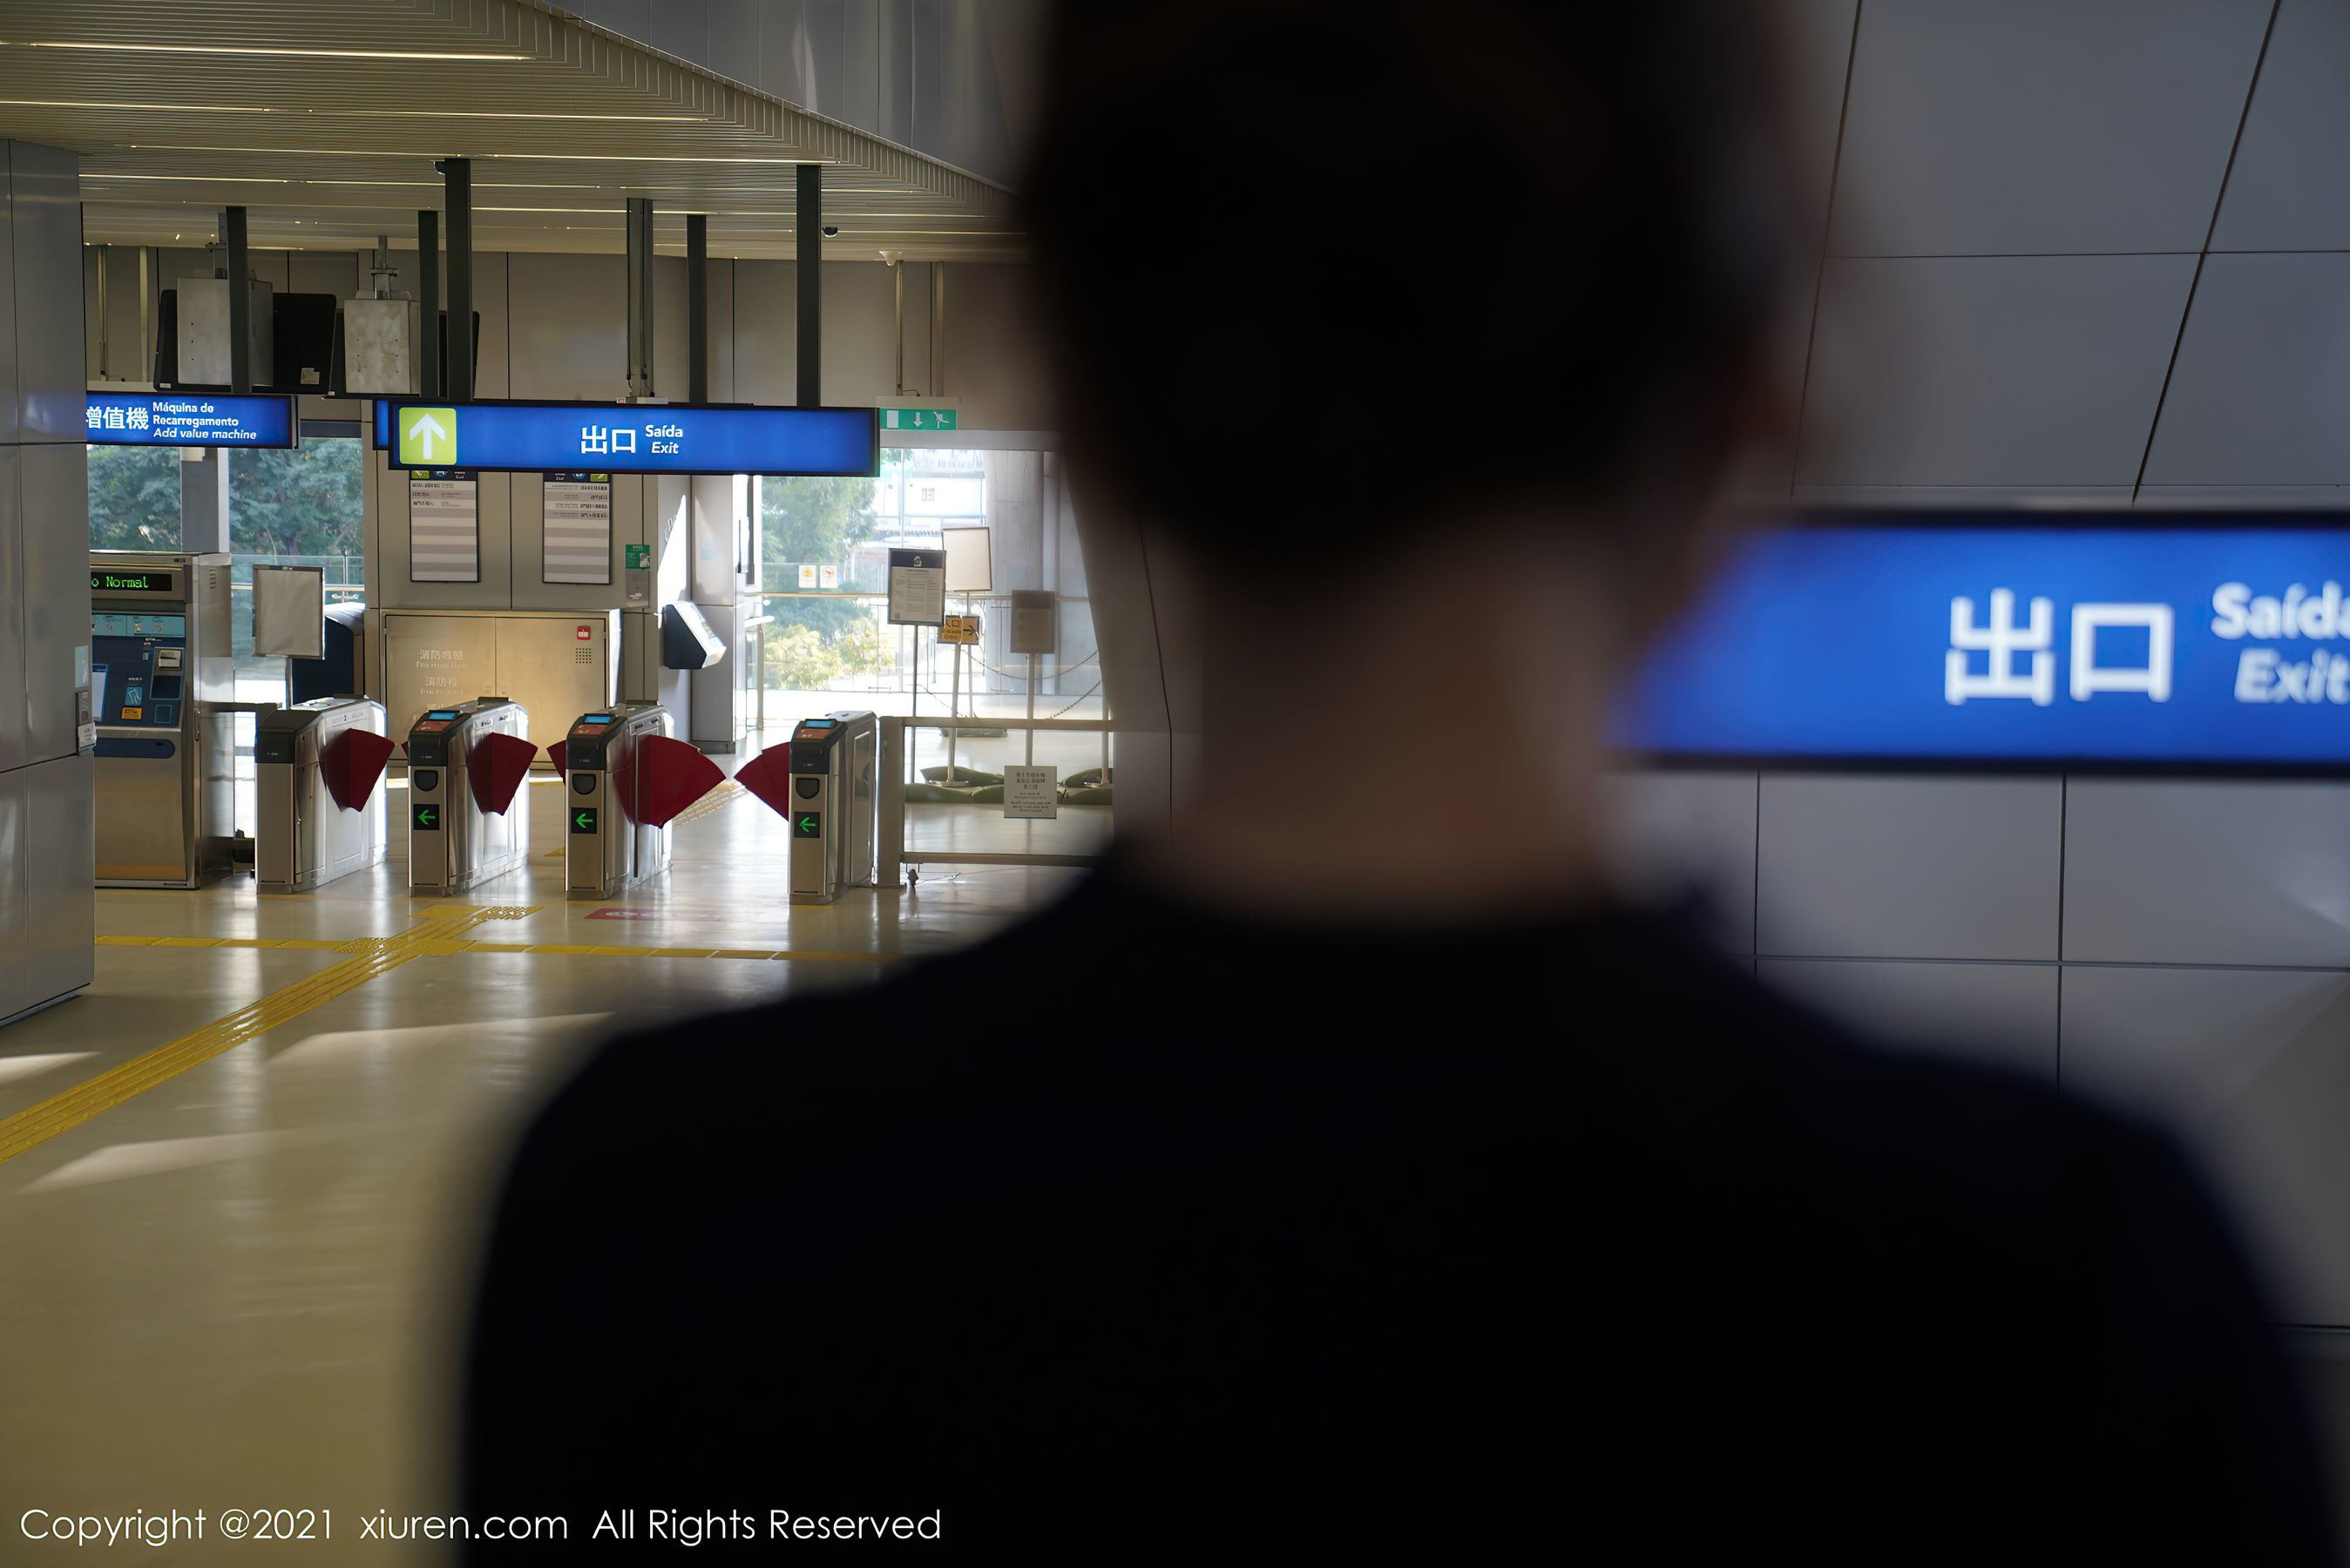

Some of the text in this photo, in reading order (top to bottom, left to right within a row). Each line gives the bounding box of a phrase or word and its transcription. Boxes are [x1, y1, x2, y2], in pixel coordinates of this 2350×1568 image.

[152, 402, 214, 414] Máquina de
[85, 406, 149, 429] 增值機
[152, 416, 240, 428] Recarregamento
[152, 428, 257, 440] Add value machine
[645, 424, 683, 437] Saída
[580, 425, 636, 454] 出口
[651, 441, 680, 454] Exit
[106, 576, 149, 589] Normal
[1944, 587, 2175, 706] 出口
[2233, 647, 2350, 706] Exit
